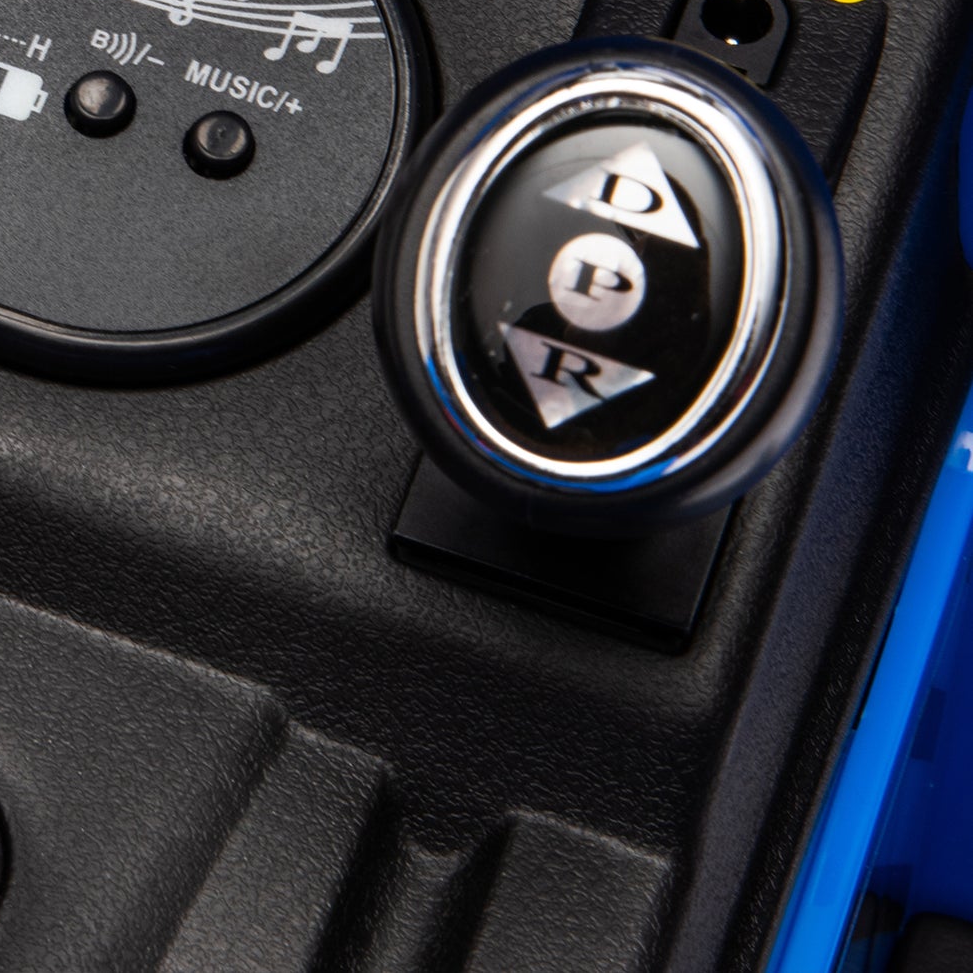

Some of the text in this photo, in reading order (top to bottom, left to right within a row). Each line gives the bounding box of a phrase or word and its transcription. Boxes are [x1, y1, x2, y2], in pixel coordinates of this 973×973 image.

[587, 165, 664, 214] D
[564, 258, 634, 302] P
[530, 341, 609, 401] R
